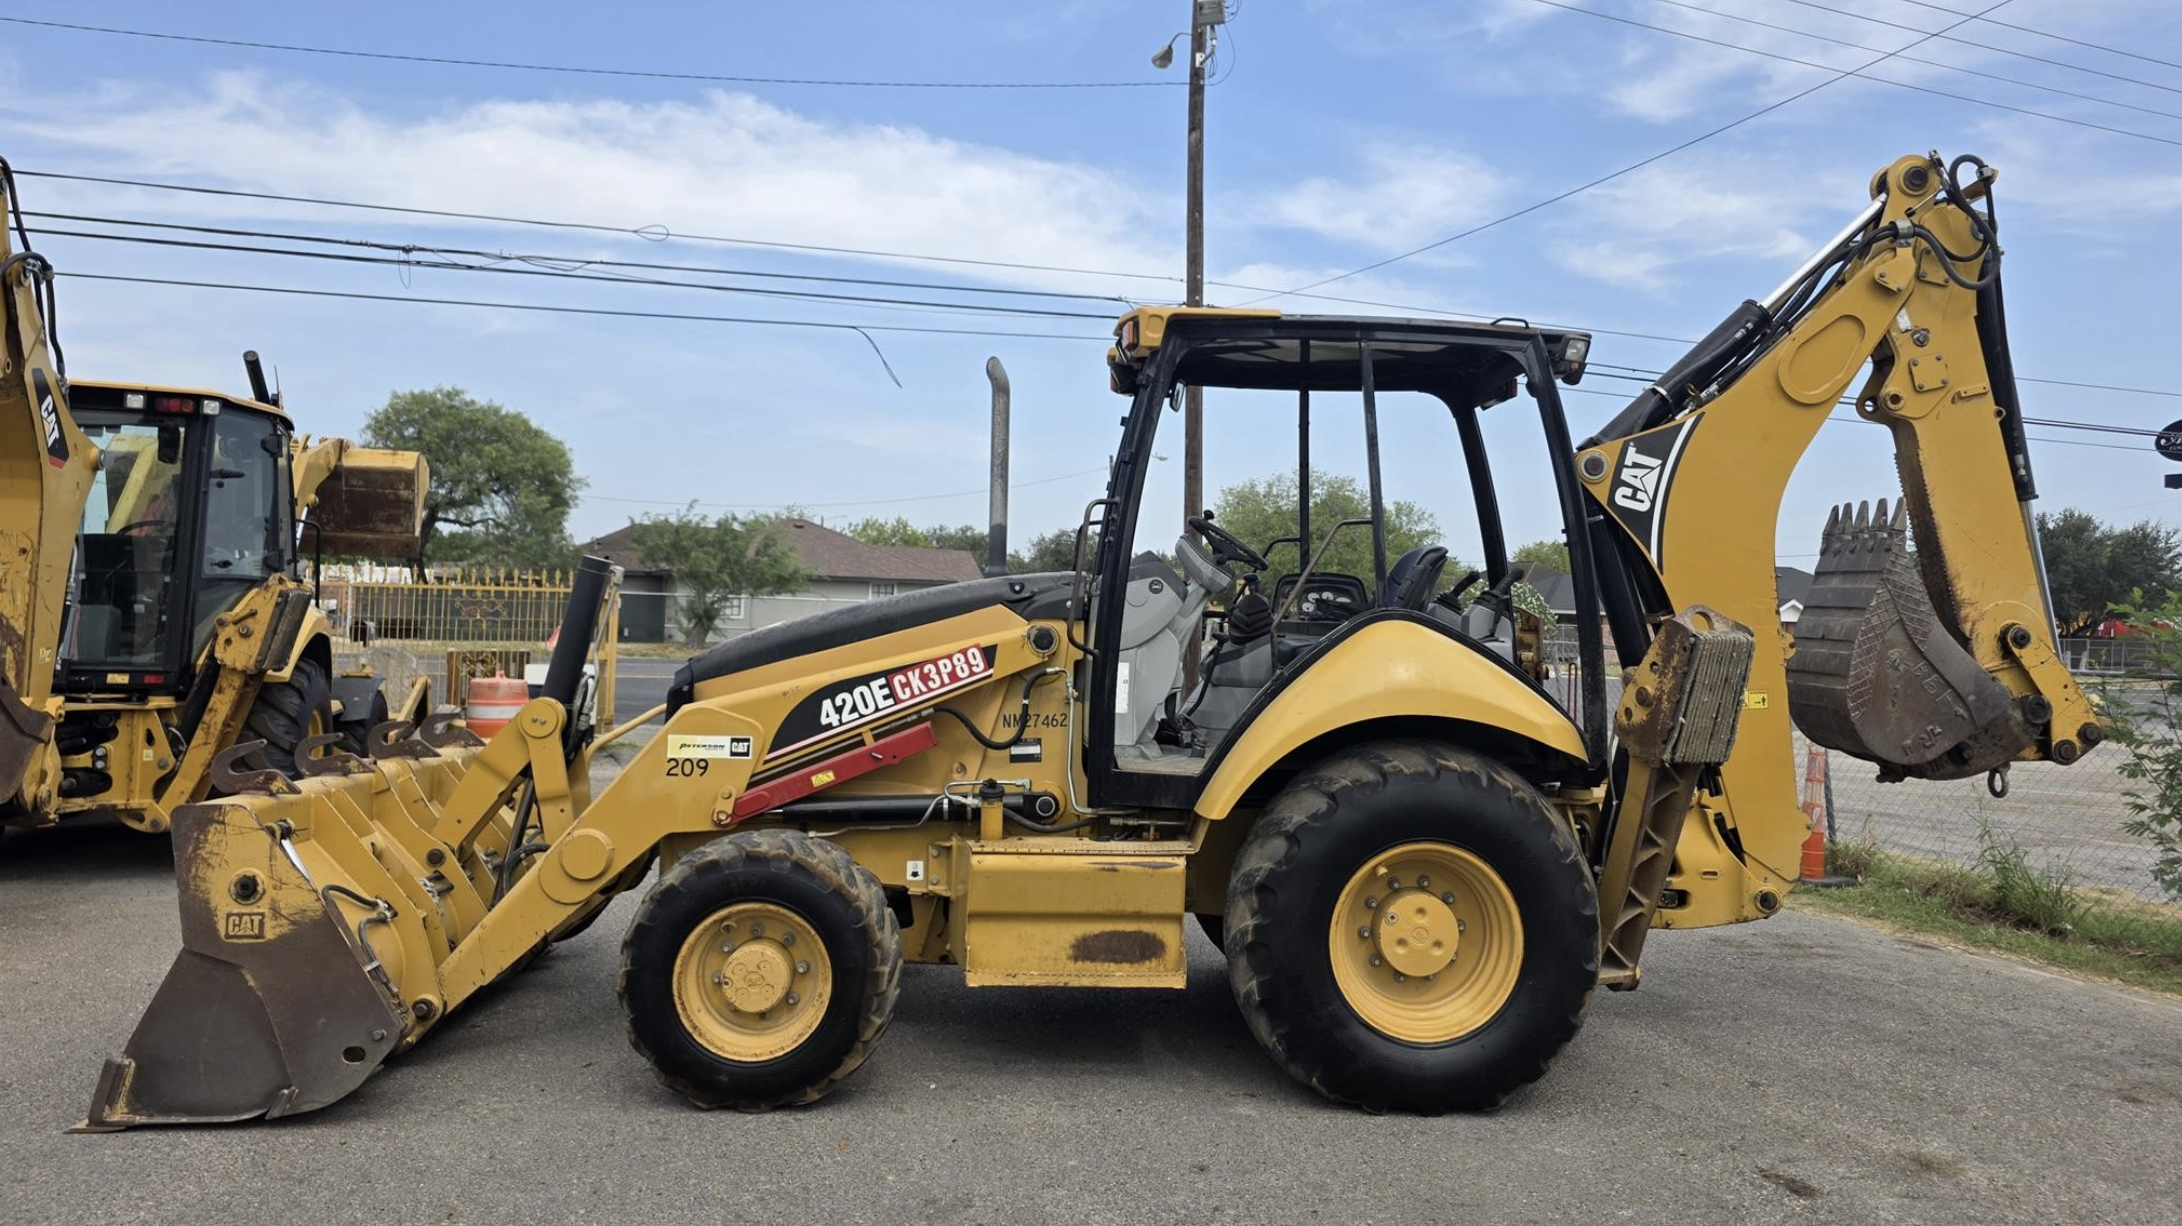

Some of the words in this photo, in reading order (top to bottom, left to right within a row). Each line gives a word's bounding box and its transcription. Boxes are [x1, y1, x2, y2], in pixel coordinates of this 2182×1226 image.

[41, 394, 60, 449] CAT
[1614, 445, 1663, 512] CAT
[820, 677, 895, 727] 420E
[892, 647, 985, 700] CK3P89
[731, 741, 750, 753] CAT
[666, 757, 709, 777] 209
[227, 915, 263, 936] CAT
